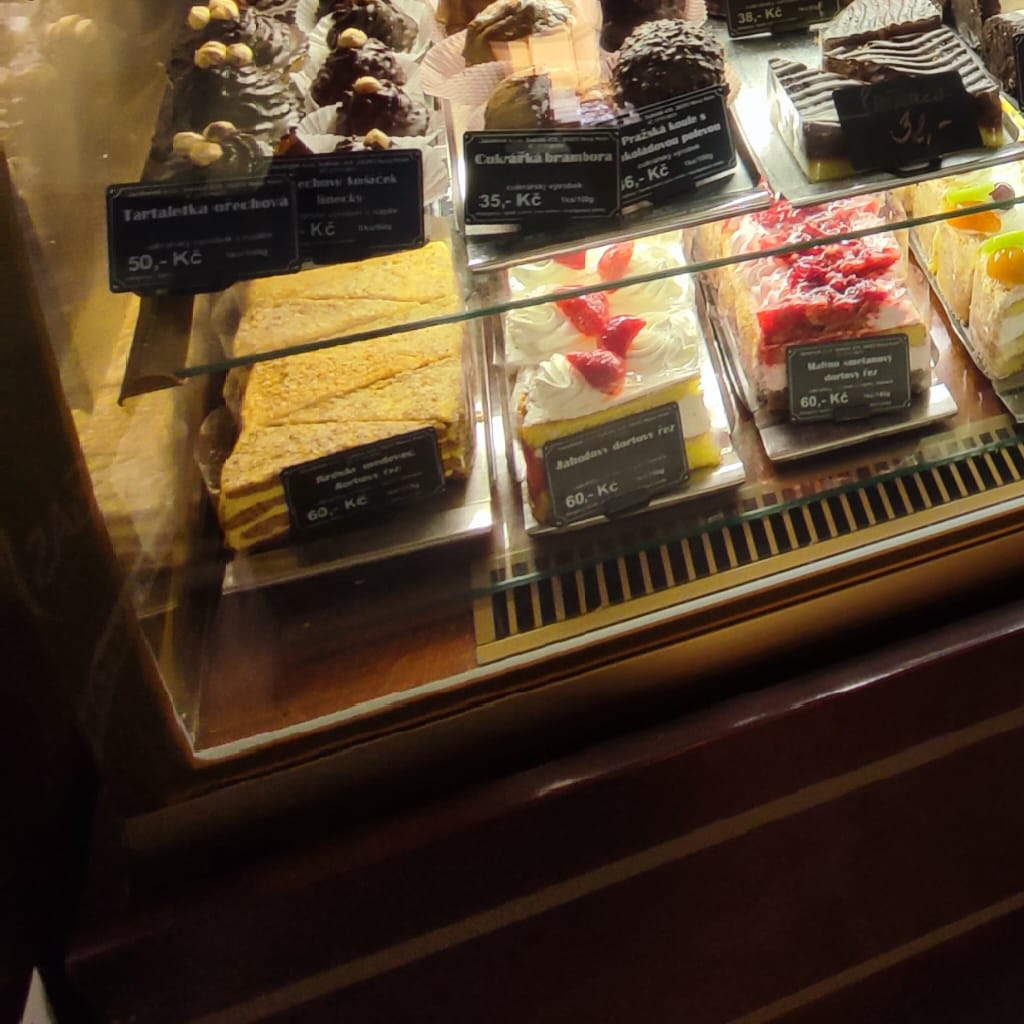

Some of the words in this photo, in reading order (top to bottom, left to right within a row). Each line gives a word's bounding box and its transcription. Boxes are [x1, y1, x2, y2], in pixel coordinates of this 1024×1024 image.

[765, 6, 784, 21] Kč
[545, 149, 613, 164] brambora
[621, 138, 680, 163] koládovou
[621, 175, 647, 193] 6,-
[647, 163, 670, 183] Kč
[478, 193, 512, 211] 35,-
[515, 191, 542, 208] Kč
[311, 221, 336, 238] Kč
[127, 253, 169, 273] 50,-
[172, 250, 204, 267] Kč
[800, 395, 827, 409] 60,-
[830, 391, 849, 405] Kč
[565, 491, 594, 509] 60,-
[597, 481, 619, 498] Kč
